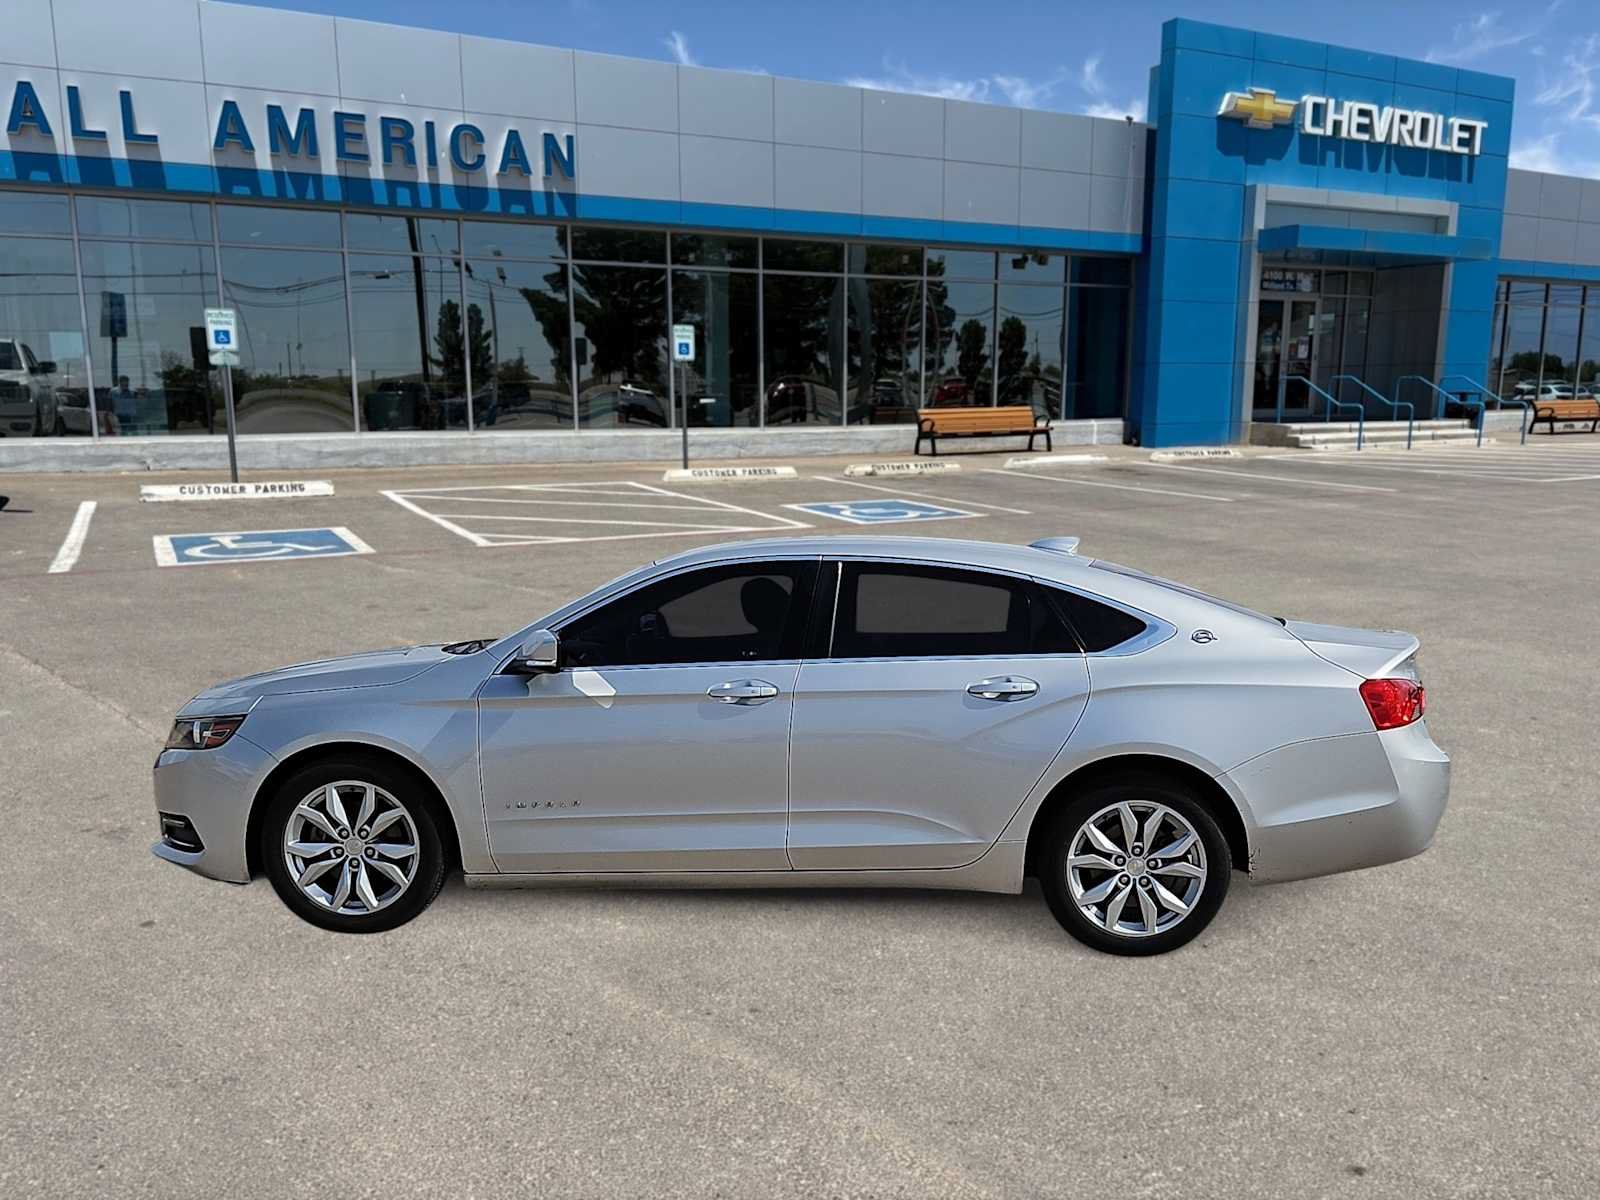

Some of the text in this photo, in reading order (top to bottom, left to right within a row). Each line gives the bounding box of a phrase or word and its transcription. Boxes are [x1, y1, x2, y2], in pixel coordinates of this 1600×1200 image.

[7, 80, 575, 180] ALL AMERICAN
[1301, 94, 1488, 155] CHEVROLET
[179, 483, 306, 495] CUSTOMER PARKING
[691, 467, 777, 477] CUSTOMER PARKING
